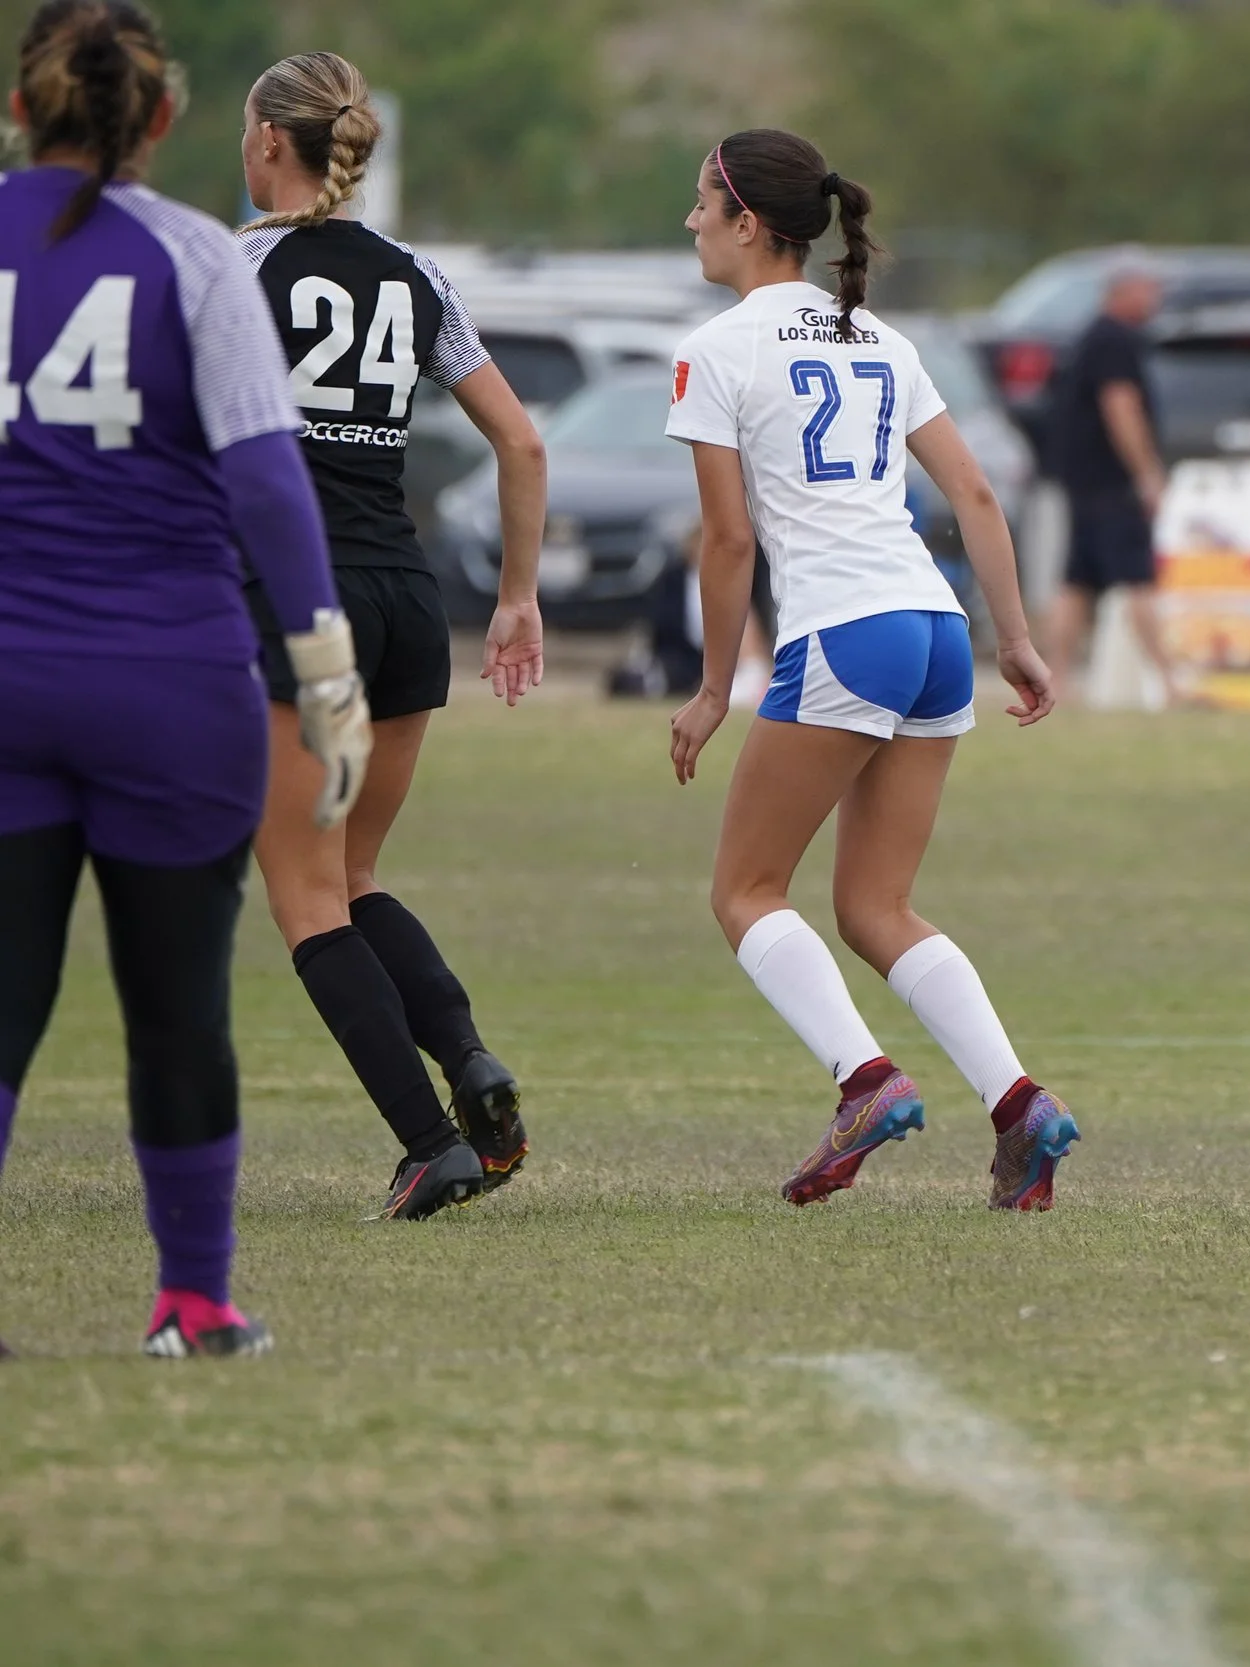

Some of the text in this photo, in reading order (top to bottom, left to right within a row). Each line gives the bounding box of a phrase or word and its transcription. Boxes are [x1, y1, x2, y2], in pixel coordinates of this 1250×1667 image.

[288, 275, 419, 418] 24
[778, 327, 879, 344] LOS ANGELES
[802, 314, 843, 328] SUR
[0, 269, 141, 450] 4
[297, 420, 408, 447] OCCER.COM
[789, 359, 896, 483] 27
